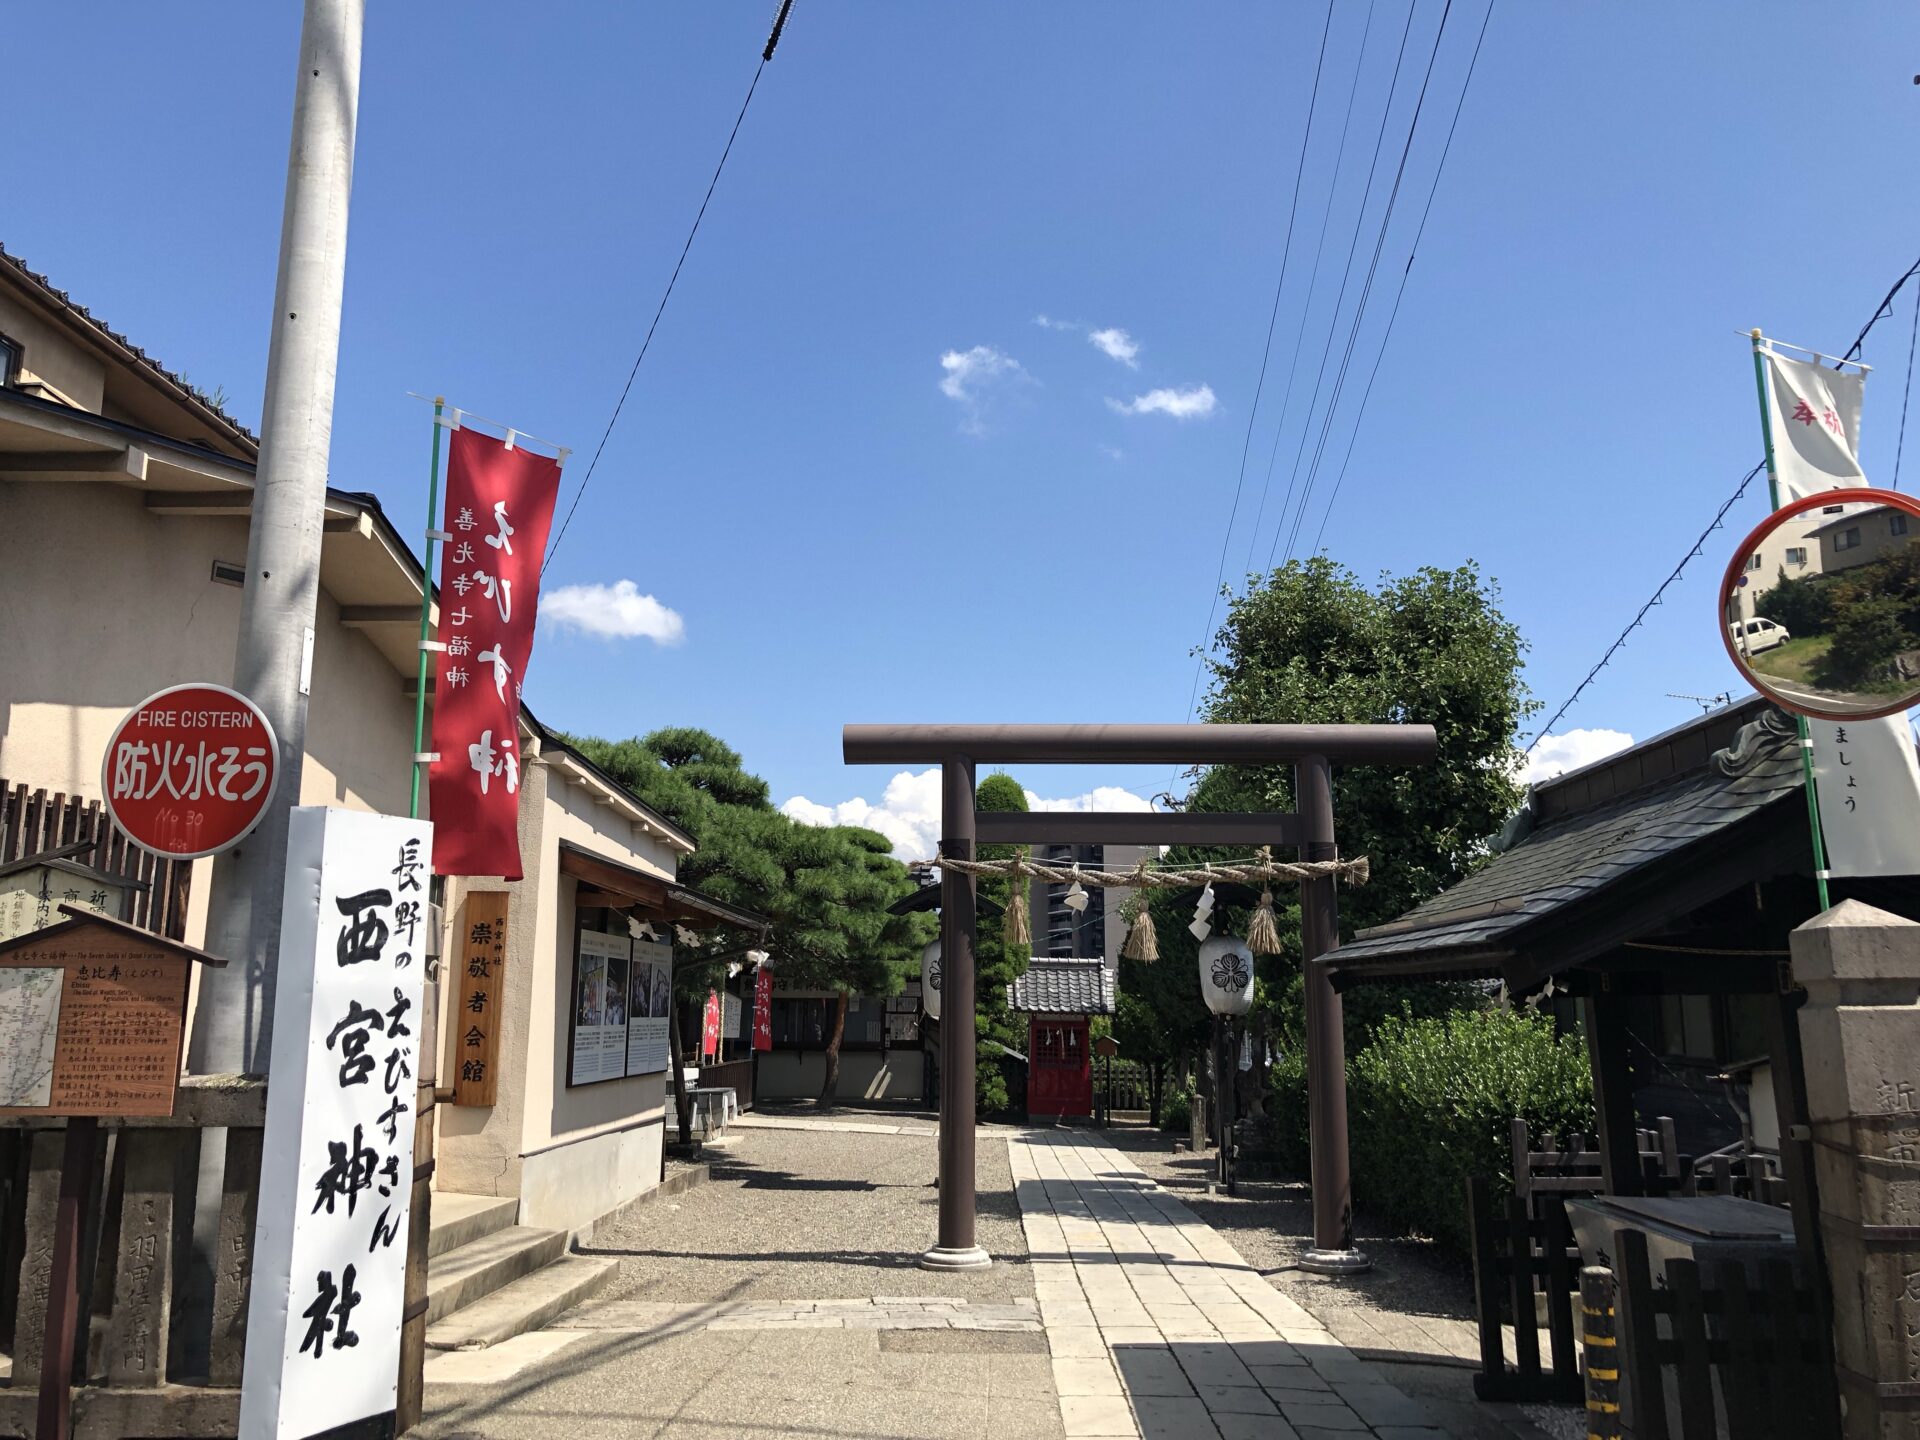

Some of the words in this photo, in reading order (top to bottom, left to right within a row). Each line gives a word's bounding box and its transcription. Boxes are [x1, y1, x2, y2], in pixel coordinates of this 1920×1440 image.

[137, 710, 177, 727] FIRE
[180, 710, 253, 728] CISTERN
[113, 739, 267, 801] 防火水そう
[185, 809, 204, 826] 30
[493, 917, 505, 966] 西宮神社
[460, 922, 492, 1083] 崇敬者会館
[368, 837, 424, 1254] 長野のえびすさん
[298, 888, 393, 1360] 西宮神社
